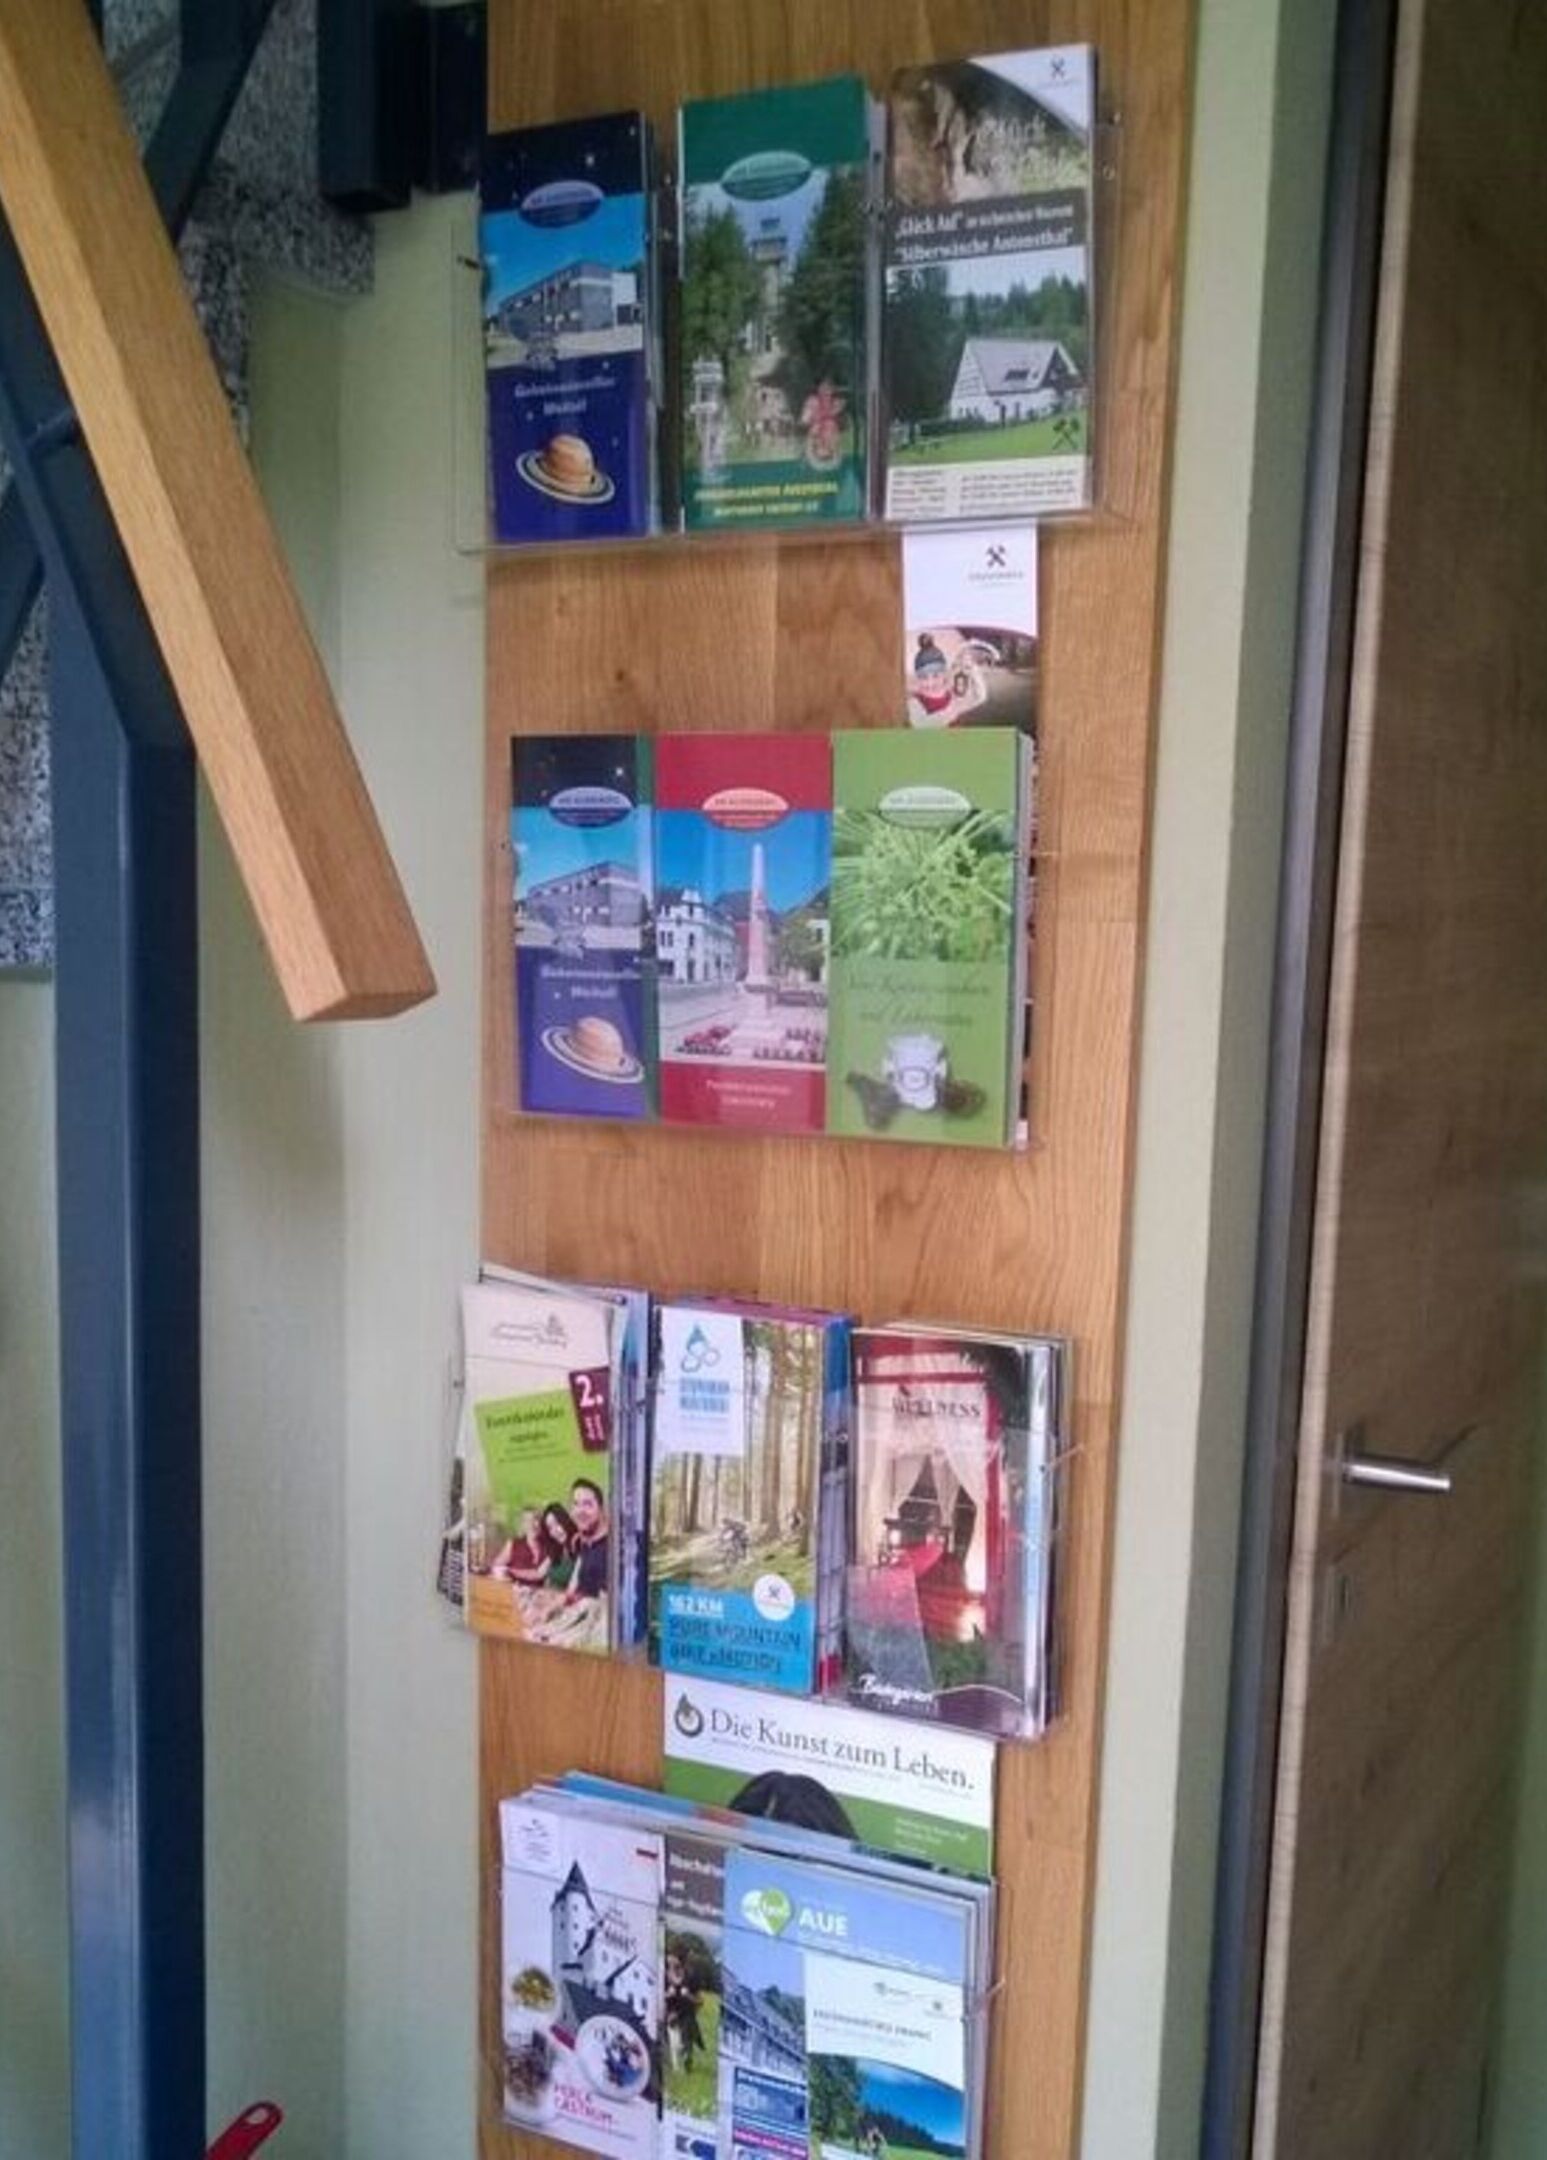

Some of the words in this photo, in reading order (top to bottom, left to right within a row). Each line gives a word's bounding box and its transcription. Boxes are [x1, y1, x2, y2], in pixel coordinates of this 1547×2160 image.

[575, 1374, 604, 1408] 2.
[711, 1708, 751, 1739] Die
[757, 1717, 829, 1756] Kunst
[834, 1737, 888, 1769] zum
[893, 1745, 976, 1791] Leben.
[799, 1906, 848, 1937] AUE
